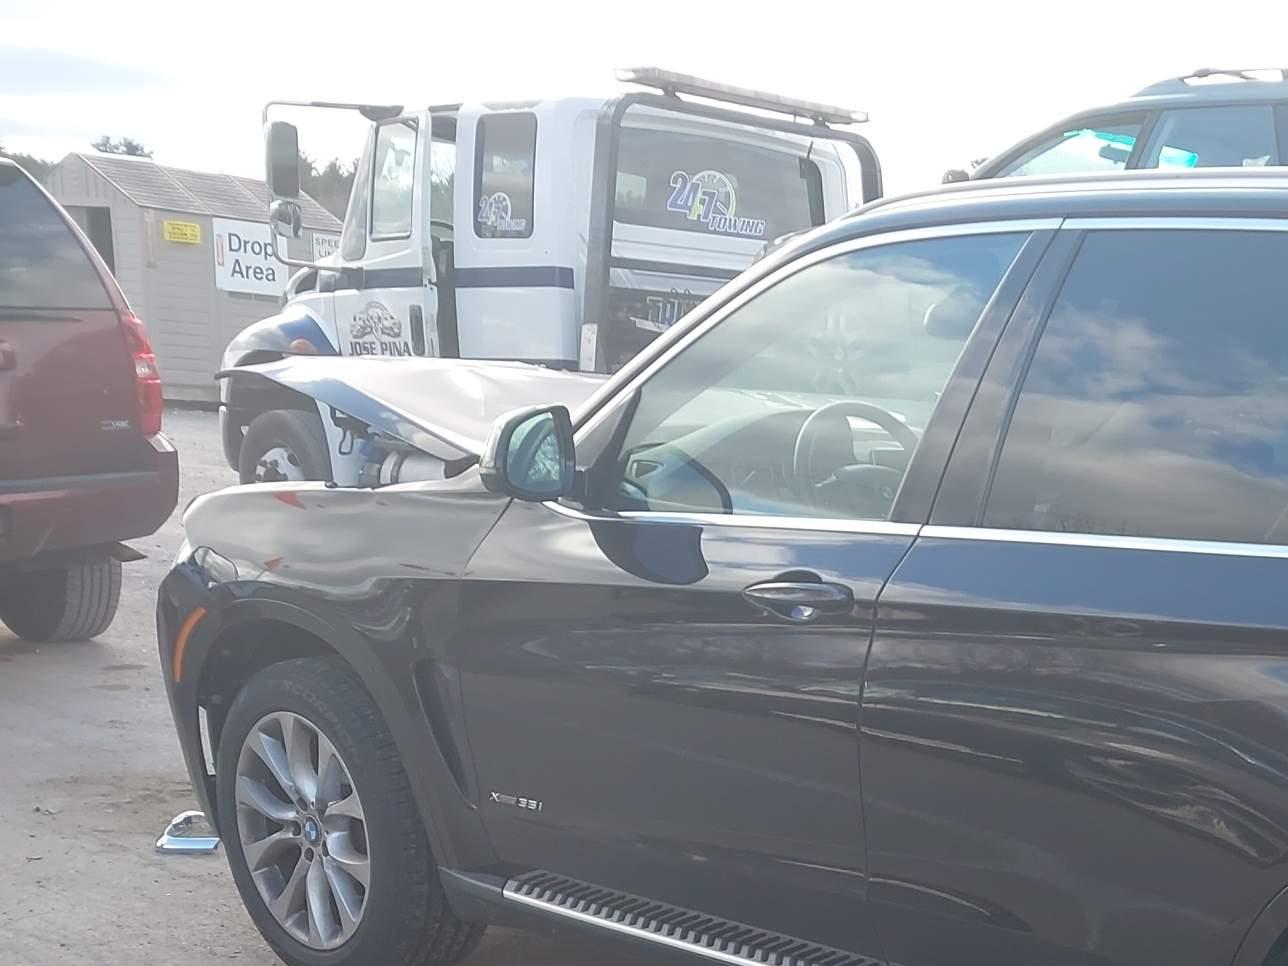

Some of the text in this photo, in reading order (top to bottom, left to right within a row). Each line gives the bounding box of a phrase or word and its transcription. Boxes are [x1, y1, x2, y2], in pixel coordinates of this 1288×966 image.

[709, 214, 766, 235] TOWING
[228, 232, 274, 260] Drop
[315, 237, 340, 249] SPEE
[230, 259, 276, 282] Area
[349, 341, 412, 356] JOSE PINA
